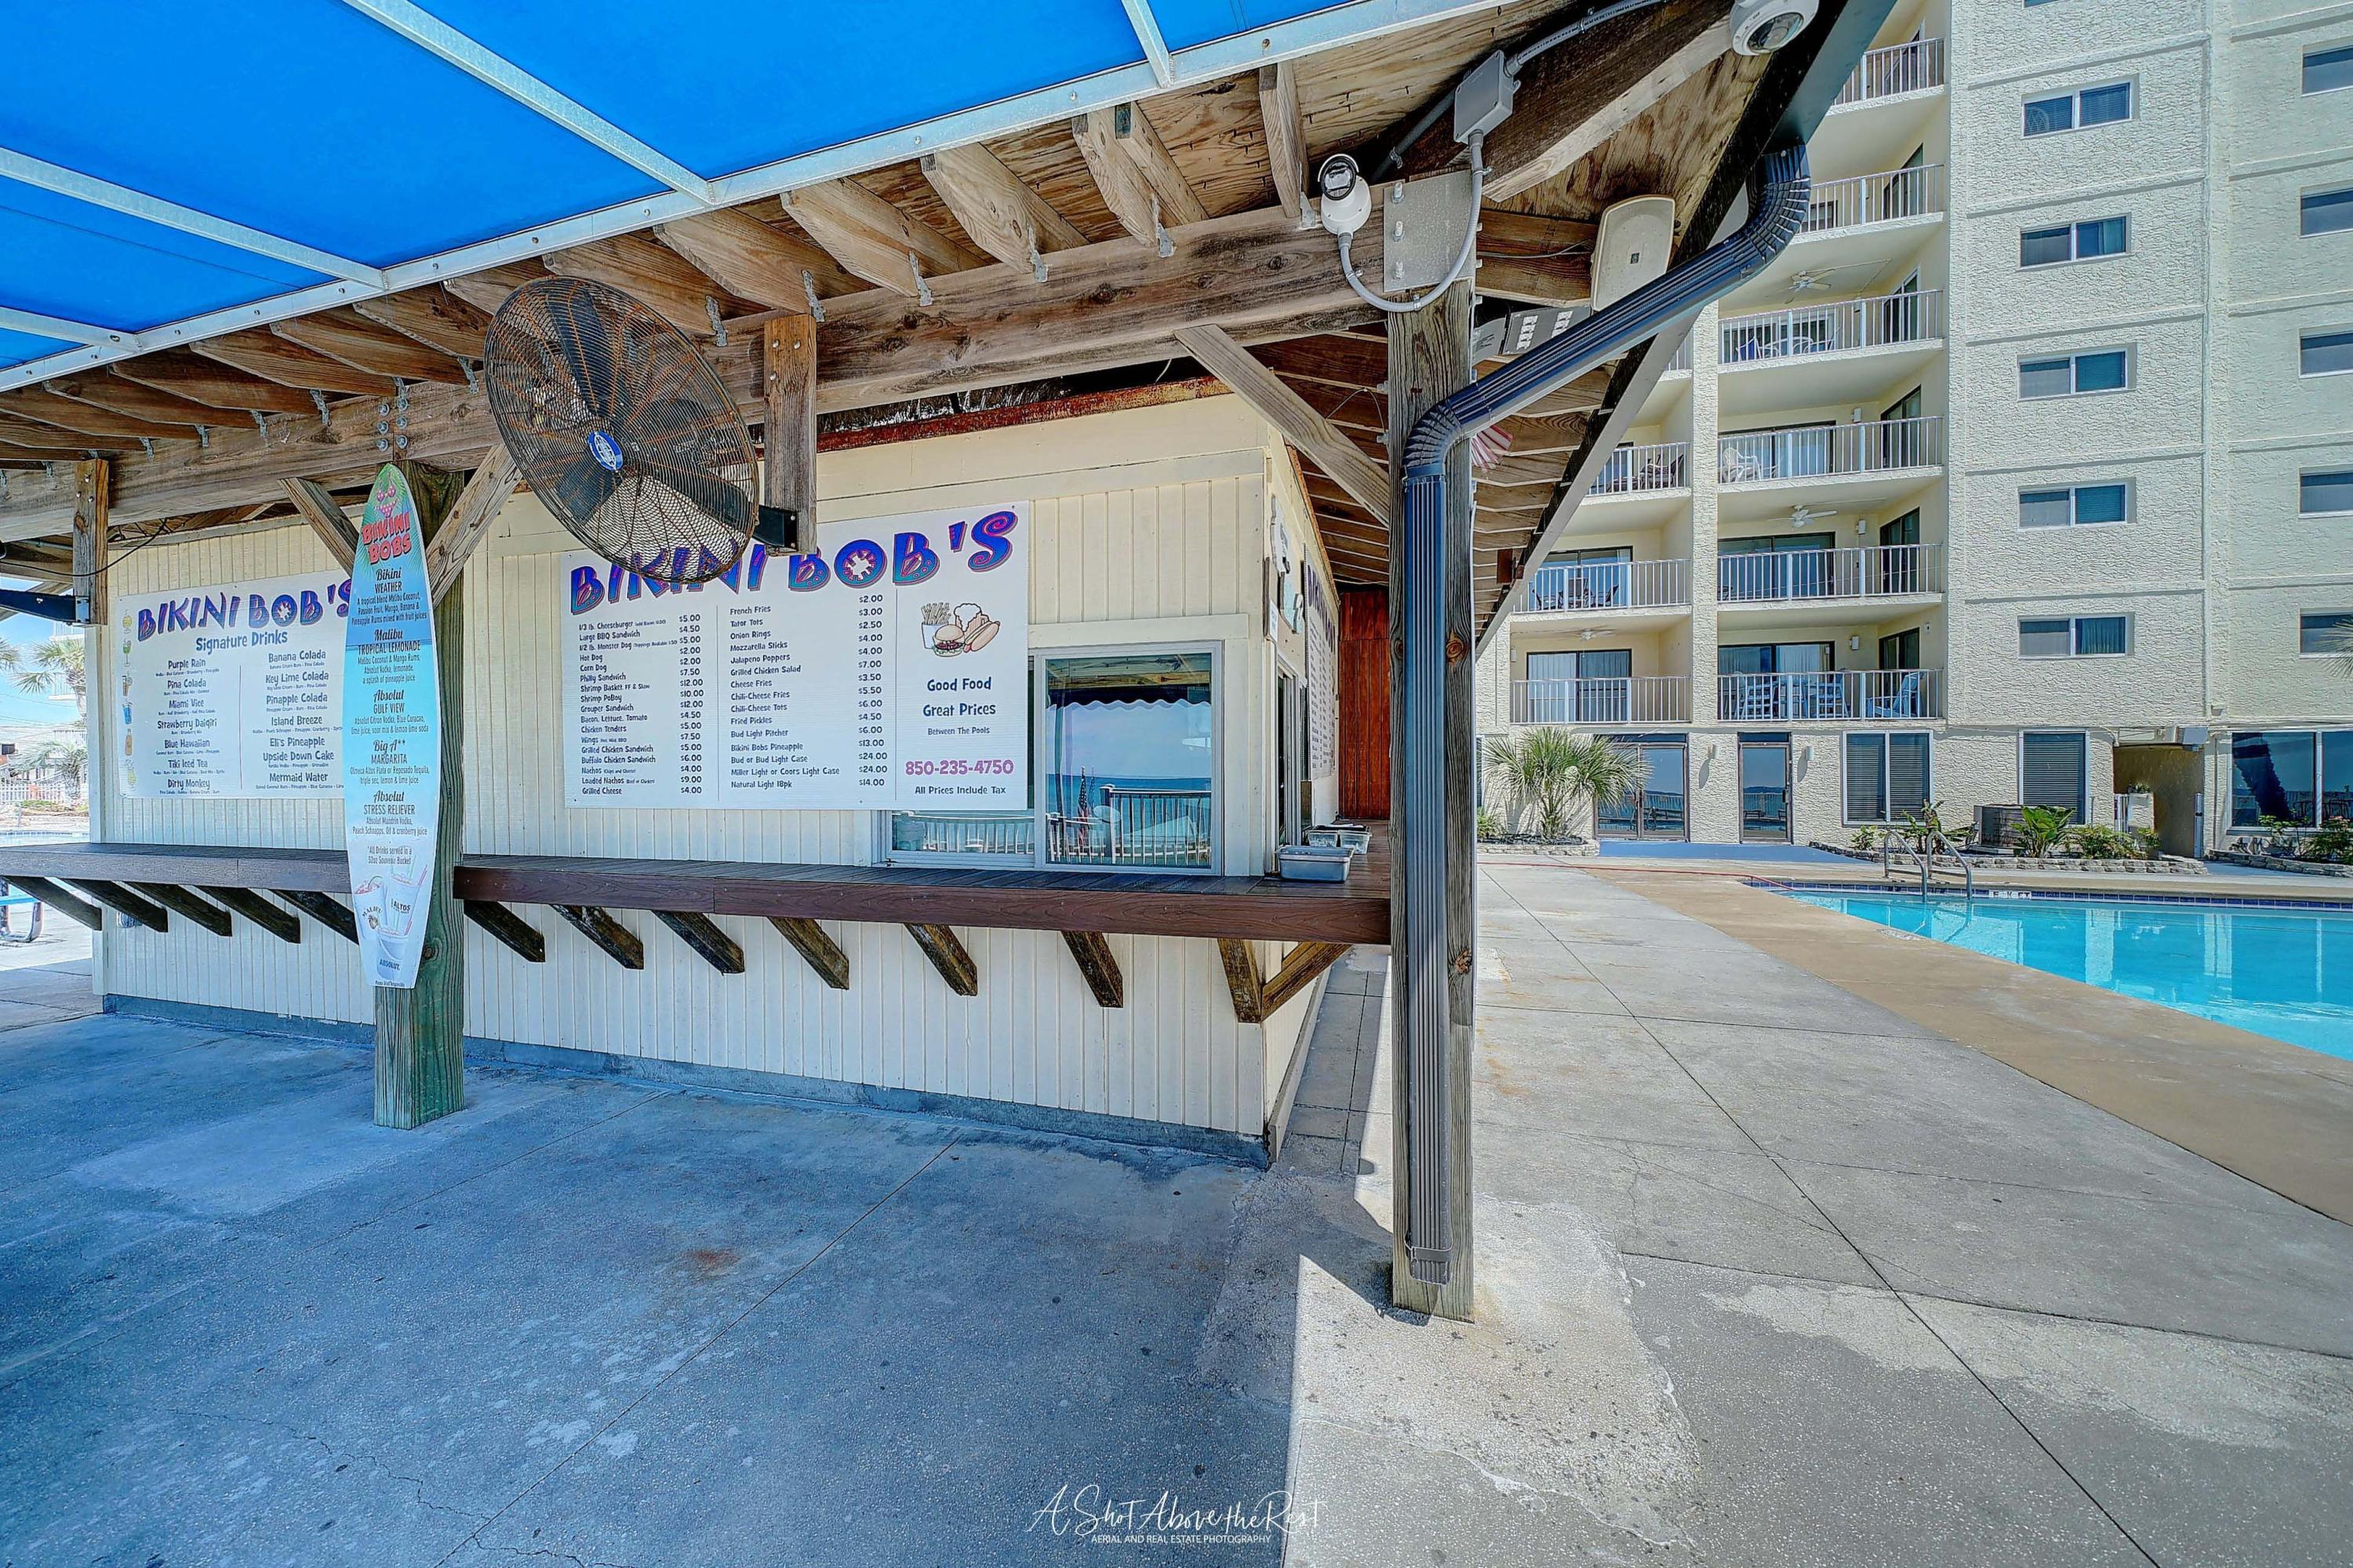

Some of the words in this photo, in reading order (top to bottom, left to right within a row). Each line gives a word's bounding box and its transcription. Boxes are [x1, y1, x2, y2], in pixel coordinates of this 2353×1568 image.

[362, 511, 410, 546] BIKINI
[367, 533, 412, 565] BOBS
[788, 510, 1019, 592] BOB'S
[376, 567, 402, 581] Bikini
[375, 581, 402, 595] WEATHER
[362, 595, 376, 606] tropical
[859, 595, 883, 603] $2.00
[730, 606, 752, 615] French
[859, 607, 882, 616] $3.00
[138, 591, 241, 642] BIKINI
[859, 620, 882, 629] $2.50
[374, 629, 403, 641] Malibu
[752, 631, 771, 639] Rings
[196, 635, 247, 655] Signature
[251, 630, 288, 646] Drinks
[358, 644, 386, 655] TROPICAL
[389, 641, 420, 653] LEMONADE
[269, 653, 296, 663] Banana
[300, 649, 326, 660] Colada
[591, 653, 602, 662] Dog
[730, 657, 760, 665] Jalapeno
[762, 654, 791, 663] Poppers
[168, 659, 188, 670] Purple
[191, 659, 205, 668] Rain
[596, 664, 607, 673] Dog
[858, 660, 882, 668] $7.00
[731, 668, 751, 676] Grilled
[754, 666, 779, 675] Chicken
[266, 675, 278, 686] Key
[281, 673, 300, 682] Lime
[302, 671, 329, 681] Colada
[580, 675, 595, 683] Philly
[858, 673, 882, 682] $3.50
[168, 680, 182, 689] Pina
[184, 678, 206, 688] Colada
[927, 678, 958, 691] Good
[962, 677, 991, 690] Food
[267, 694, 298, 706] Pinapple
[301, 693, 327, 703] Colada
[373, 689, 404, 703] Absolut
[169, 700, 189, 708] Miami
[191, 699, 204, 708] Vice
[373, 704, 388, 714] GULF
[390, 703, 405, 713] VIEW
[923, 704, 955, 717] Great
[959, 703, 996, 715] Prices
[158, 720, 193, 730] Strawberry
[271, 716, 294, 726] Island
[297, 715, 322, 725] Breeze
[746, 730, 762, 739] Light
[165, 740, 178, 748] Blue
[180, 739, 210, 748] Hawaiian
[270, 738, 284, 747] Eli's
[288, 737, 325, 748] Pineapple
[373, 740, 388, 755] Big
[770, 743, 803, 752] Pineapple
[263, 751, 288, 762] Upside
[290, 751, 312, 760] Down
[315, 751, 334, 760] Cake
[371, 754, 407, 764] MARGARITA
[771, 755, 788, 765] Light
[168, 759, 180, 768] Tiki
[182, 759, 195, 768] Iced
[905, 759, 1014, 776] 850-235-4750
[269, 773, 303, 782] Mermaid
[305, 773, 328, 781] Water
[751, 769, 768, 777] Light
[802, 767, 820, 777] Light
[168, 779, 184, 790] Dirty
[186, 779, 210, 789] Monkey
[758, 781, 774, 790] Light
[776, 781, 792, 790] 18pk
[373, 790, 404, 802] Absolut
[915, 786, 926, 795] All
[929, 786, 954, 795] Prices
[957, 786, 987, 795] Include
[364, 805, 386, 815] STRESS
[387, 805, 415, 815] RELIEVER
[393, 899, 411, 911] ALTOS
